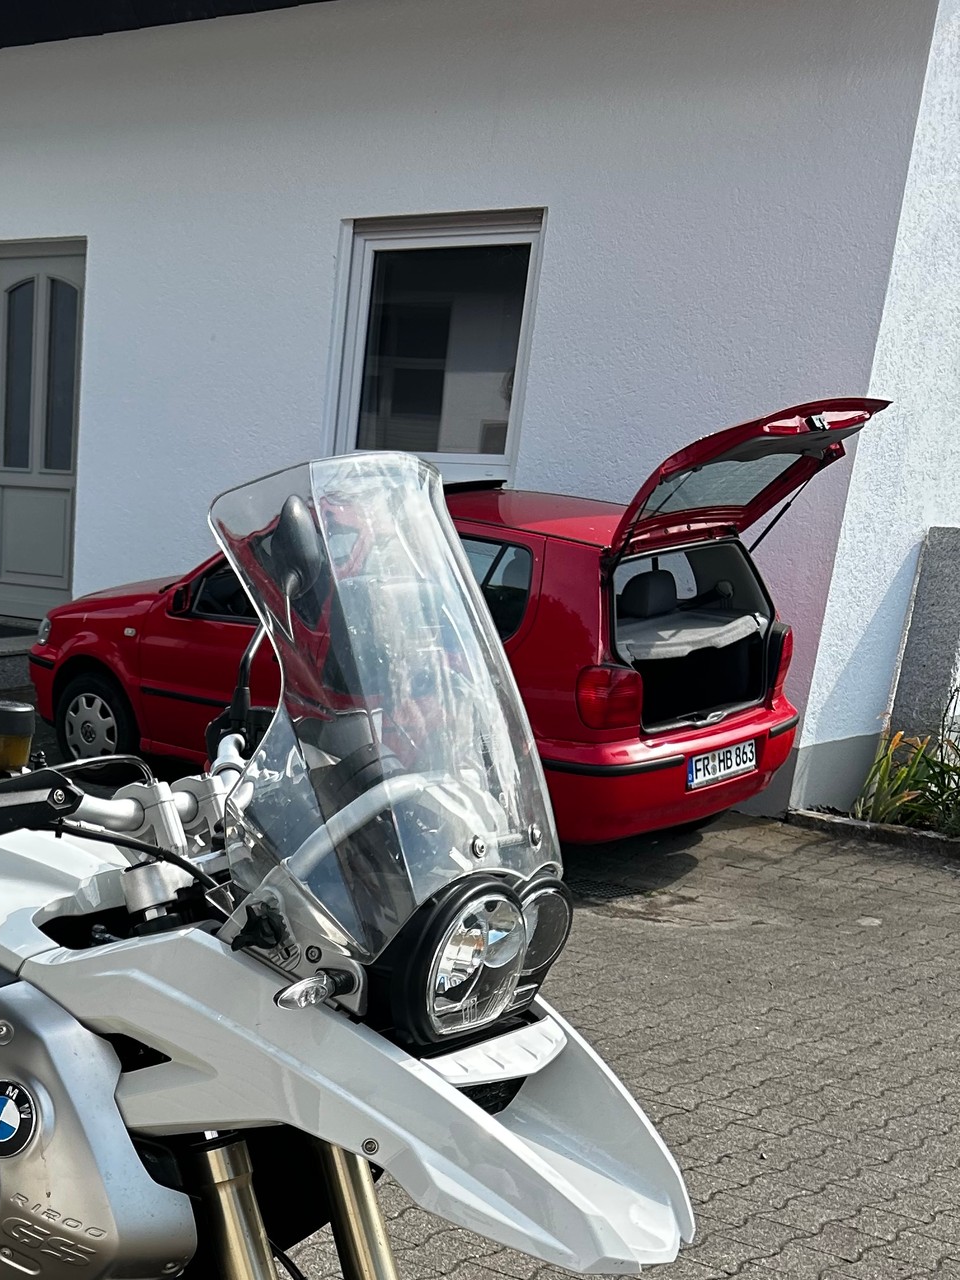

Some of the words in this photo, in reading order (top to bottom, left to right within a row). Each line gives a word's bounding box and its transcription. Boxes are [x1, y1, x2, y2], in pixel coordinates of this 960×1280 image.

[694, 756, 711, 779] FR
[718, 749, 733, 772] HB
[735, 743, 755, 766] 863
[1, 1216, 97, 1267] GS
